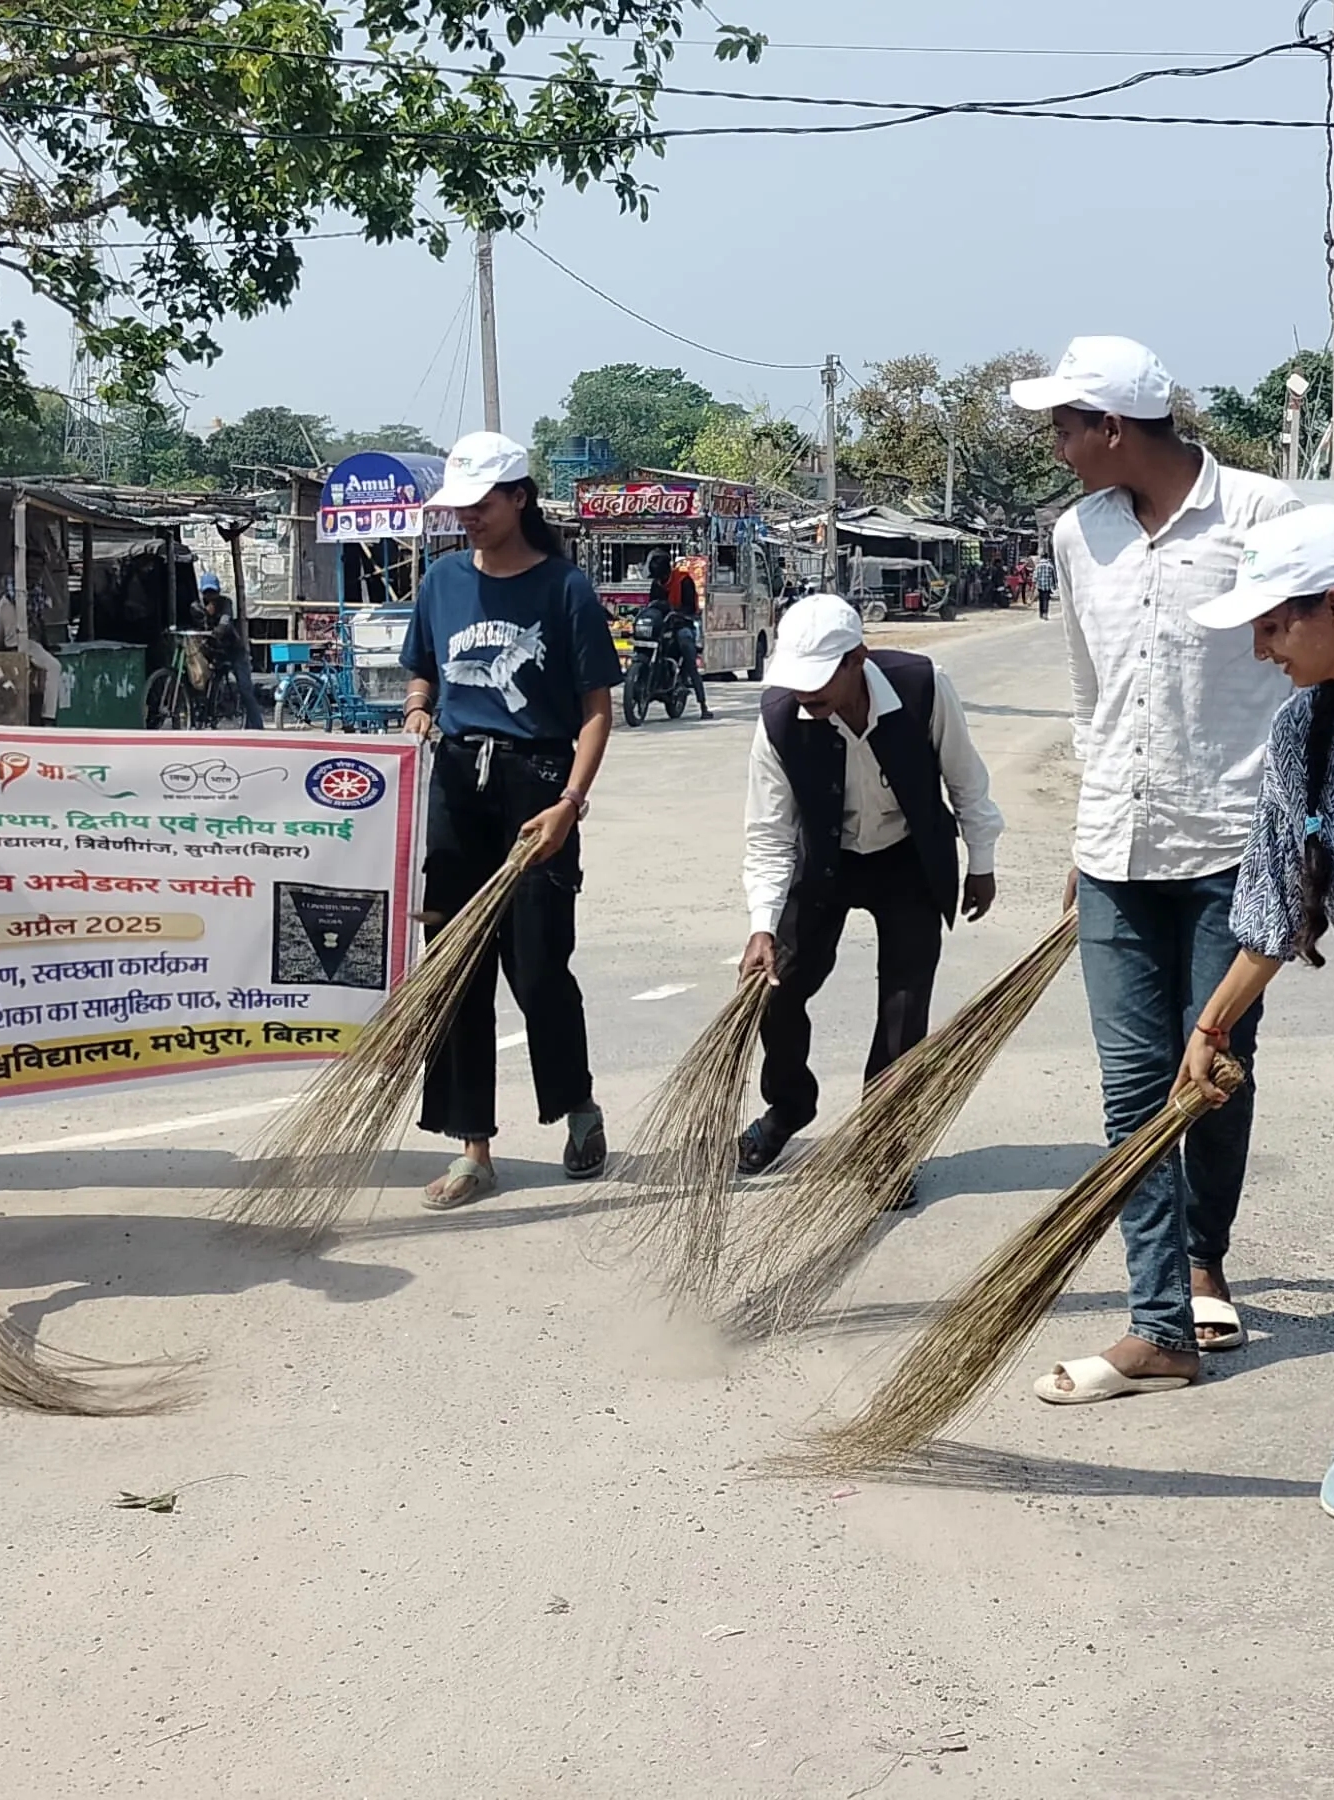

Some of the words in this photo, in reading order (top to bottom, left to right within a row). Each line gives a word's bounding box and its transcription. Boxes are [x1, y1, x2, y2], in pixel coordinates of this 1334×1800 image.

[346, 473, 395, 491] Amul
[66, 810, 151, 830] द्वितीय
[157, 812, 198, 835] एवं
[205, 815, 276, 839] तृतीय
[283, 818, 354, 841] इकाई
[75, 834, 178, 856] त्रिवेणीगंज,
[24, 870, 161, 894] अम्बेडकर
[168, 875, 255, 898] जयंती
[7, 913, 77, 938] अप्रैल
[85, 916, 162, 935] 2025
[31, 958, 114, 984] स्वच्छता
[118, 951, 209, 977] कार्यक्रम
[46, 1000, 79, 1022] का
[177, 991, 221, 1009] पाठ,
[227, 986, 310, 1010] सेमिनार
[150, 1026, 252, 1055] मधेपुरा,
[262, 1022, 341, 1044] बिहार
